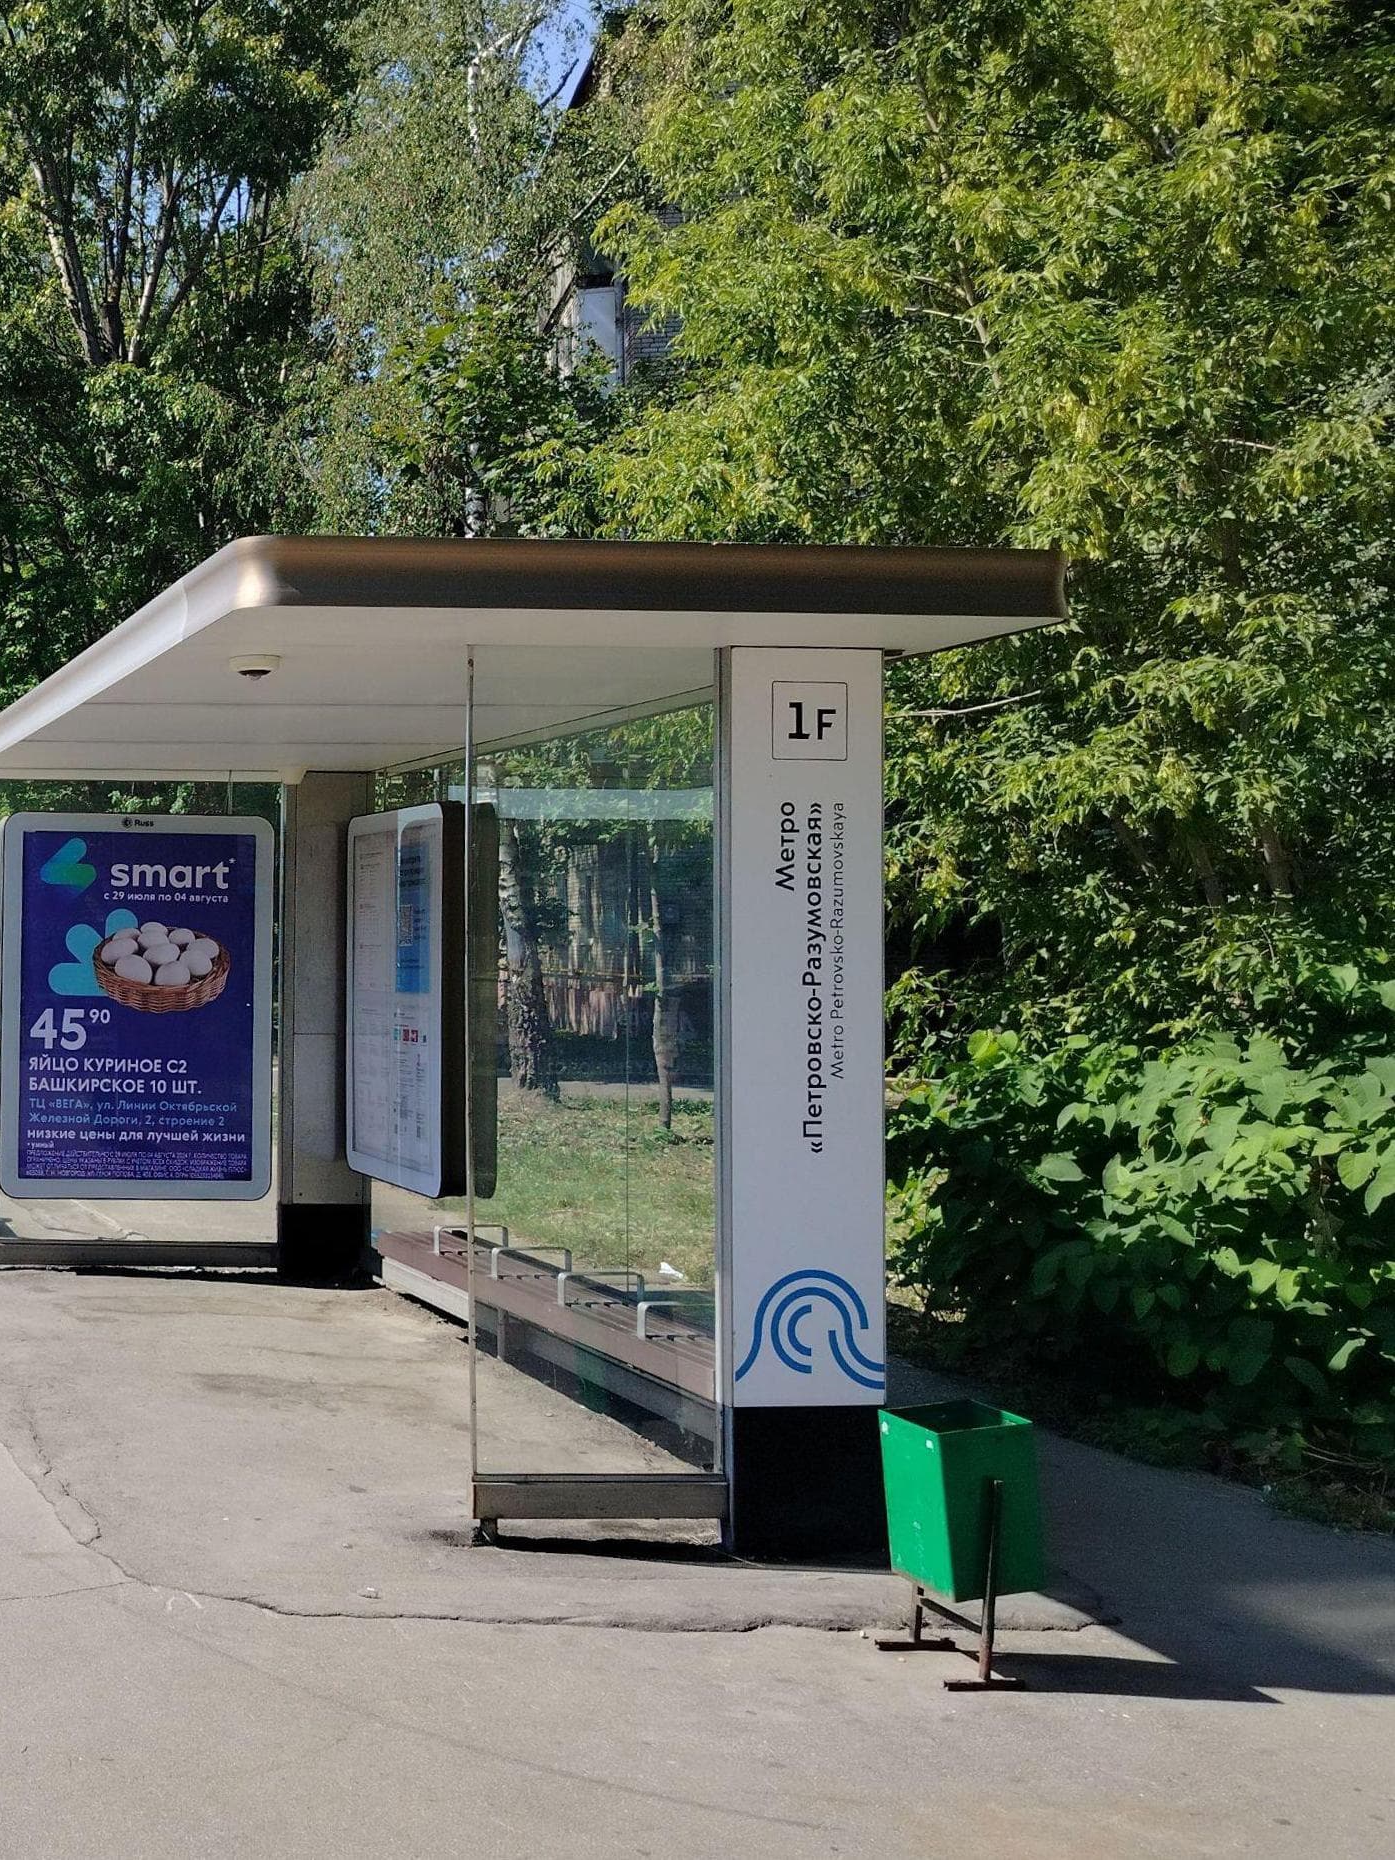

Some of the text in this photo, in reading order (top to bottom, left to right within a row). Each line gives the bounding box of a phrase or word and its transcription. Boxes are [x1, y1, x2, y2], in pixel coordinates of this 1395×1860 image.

[134, 819, 155, 828] Russ
[774, 801, 800, 892] Метро
[103, 891, 229, 905] с 29 июля по 04 августа
[830, 802, 847, 1080] Metro Petrovsko-Razumovskaya
[802, 802, 827, 1154] «Петровско-Разумовская»
[30, 1008, 111, 1051] 45 90
[28, 1054, 188, 1074] ЯЙЦО КУРИНОЕ С2
[29, 1077, 202, 1094] БАШКИРСКОЕ 10 ШТ.
[29, 1097, 46, 1110] ТЦ
[97, 1102, 114, 1110] ул.
[117, 1100, 156, 1111] Линии
[159, 1100, 237, 1113] Октябрьской
[29, 1113, 91, 1124] Железной
[145, 1115, 155, 1127] 2,
[158, 1116, 215, 1128] строение
[218, 1117, 225, 1127] 2
[27, 1129, 245, 1144] низкие цены для лучшей жизни
